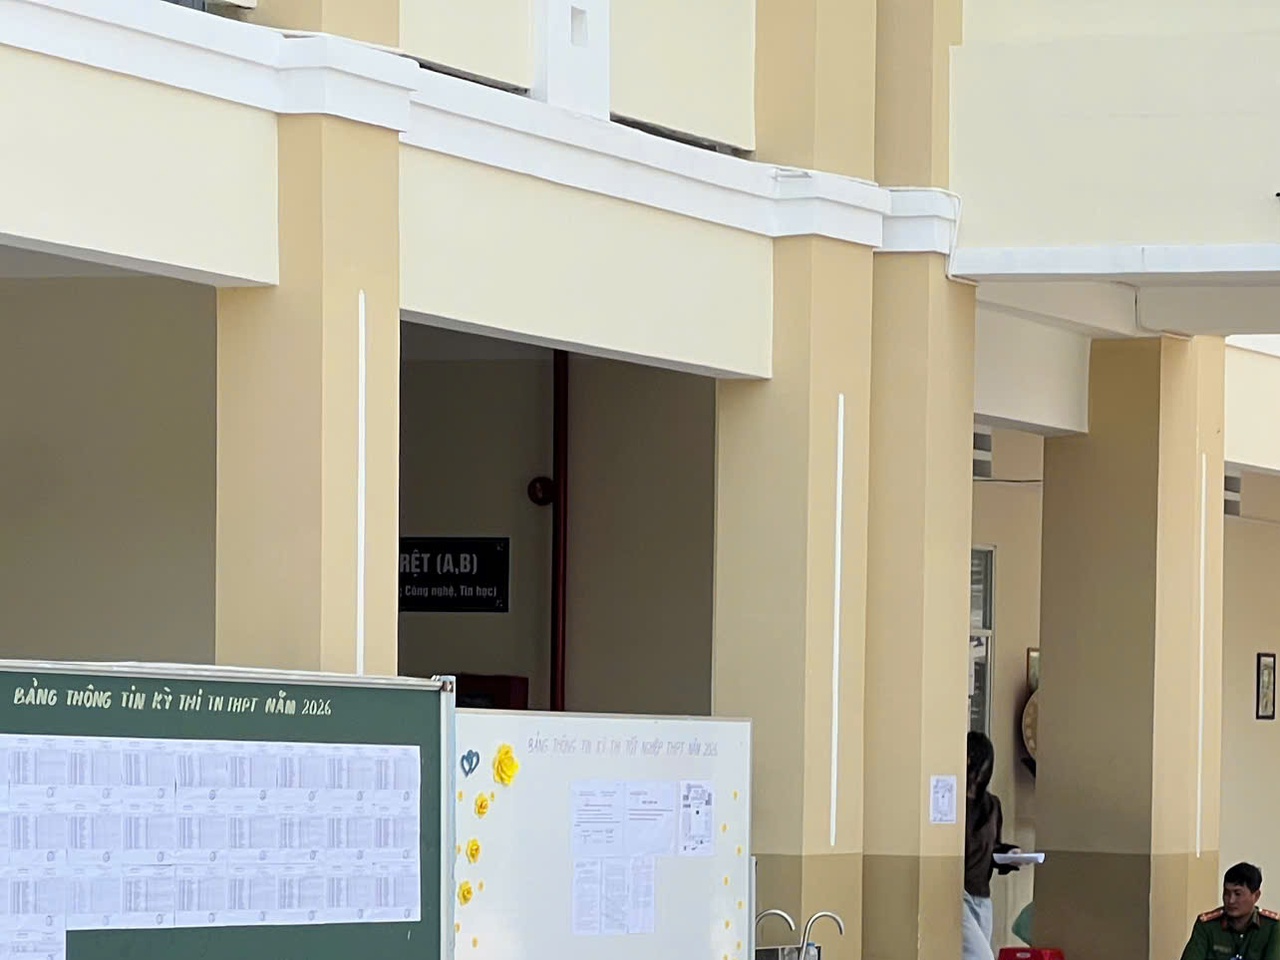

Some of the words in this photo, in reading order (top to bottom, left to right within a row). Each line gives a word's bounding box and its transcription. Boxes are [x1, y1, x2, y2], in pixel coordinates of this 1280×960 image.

[437, 553, 478, 575] (A,B)
[460, 585, 473, 597] Tin
[13, 677, 58, 707] BẢNG
[66, 684, 112, 709] THÔNG
[152, 686, 173, 710] KỲ
[208, 694, 224, 712] TN
[227, 696, 259, 713] THPT
[301, 698, 332, 716] 2026
